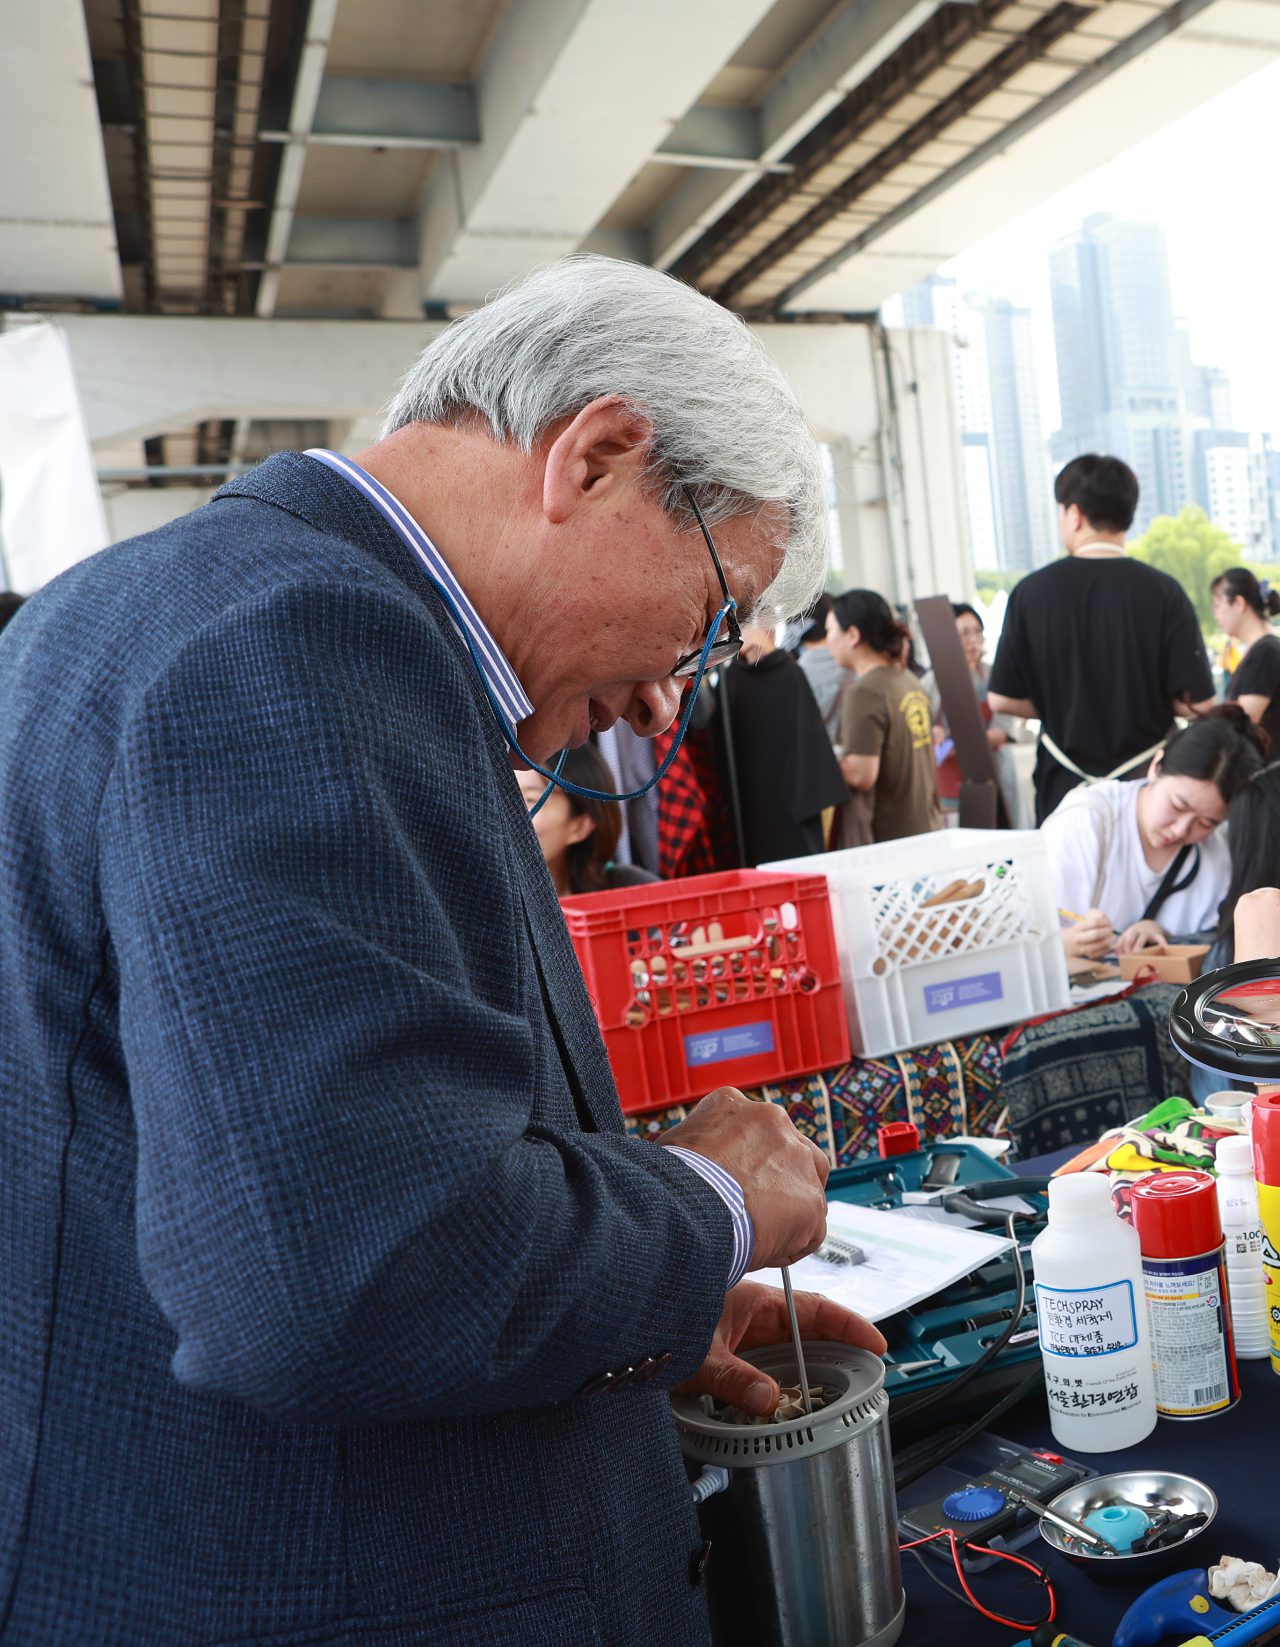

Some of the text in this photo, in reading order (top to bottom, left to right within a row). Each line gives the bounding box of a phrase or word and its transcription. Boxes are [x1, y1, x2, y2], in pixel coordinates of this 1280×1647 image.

[1042, 1296, 1104, 1314] TECHSPRAY
[1046, 1310, 1113, 1328] 친환경 세척제
[1049, 1330, 1065, 1343] TCE
[1048, 1382, 1139, 1409] 서울환경연합
[1033, 1460, 1057, 1471] HIOKI
